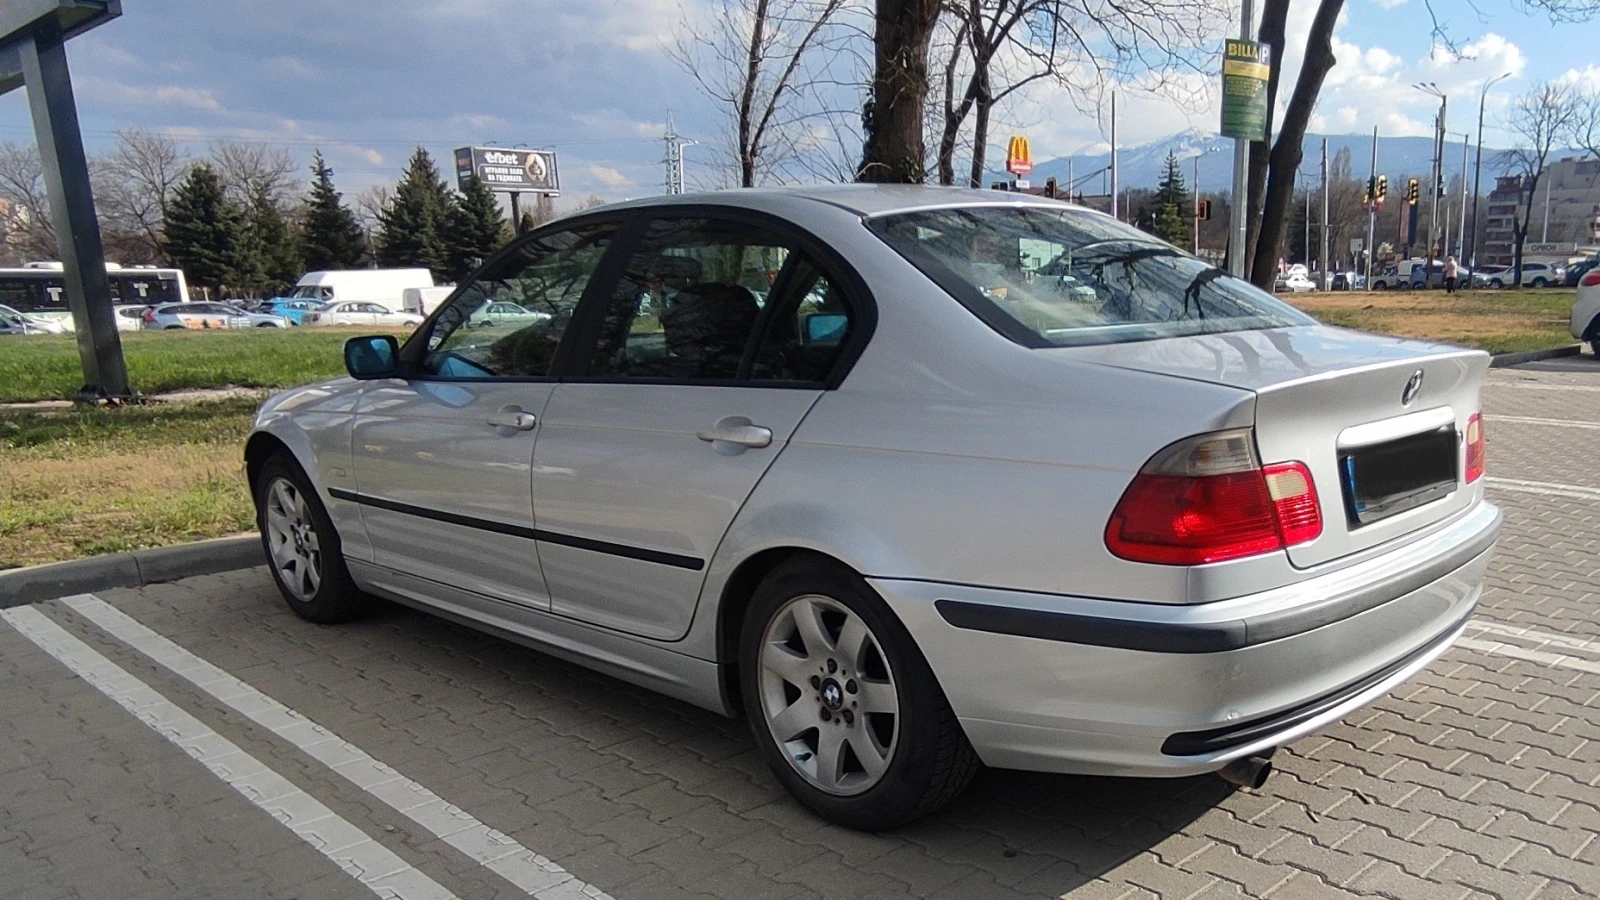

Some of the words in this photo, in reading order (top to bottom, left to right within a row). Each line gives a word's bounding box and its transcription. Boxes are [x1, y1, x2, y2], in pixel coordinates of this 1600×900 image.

[1228, 43, 1259, 59] BILLA
[1262, 46, 1269, 62] P
[484, 152, 518, 165] efbet
